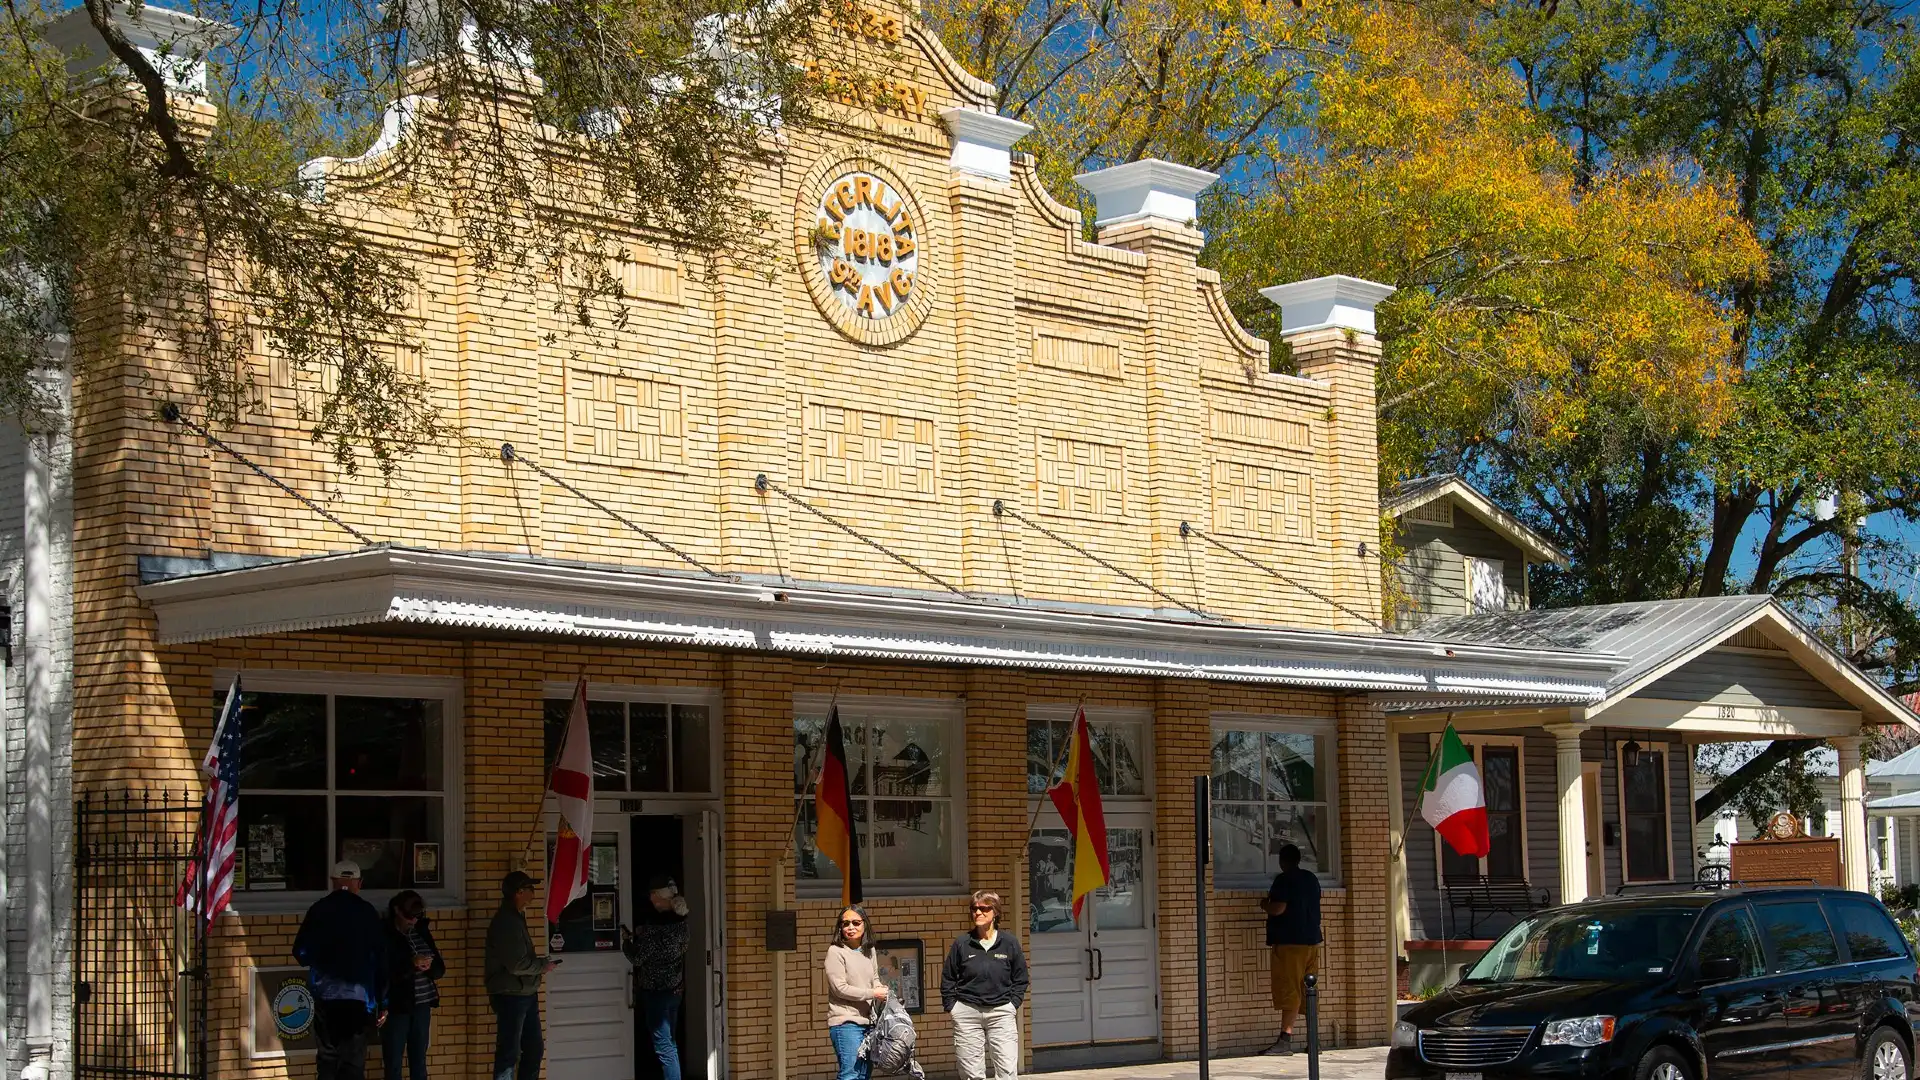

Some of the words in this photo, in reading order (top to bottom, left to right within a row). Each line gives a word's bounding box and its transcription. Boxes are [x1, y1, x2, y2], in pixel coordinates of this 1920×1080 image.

[825, 176, 916, 257] FERLITA
[844, 227, 893, 262] 1818
[1718, 705, 1735, 718] 1820
